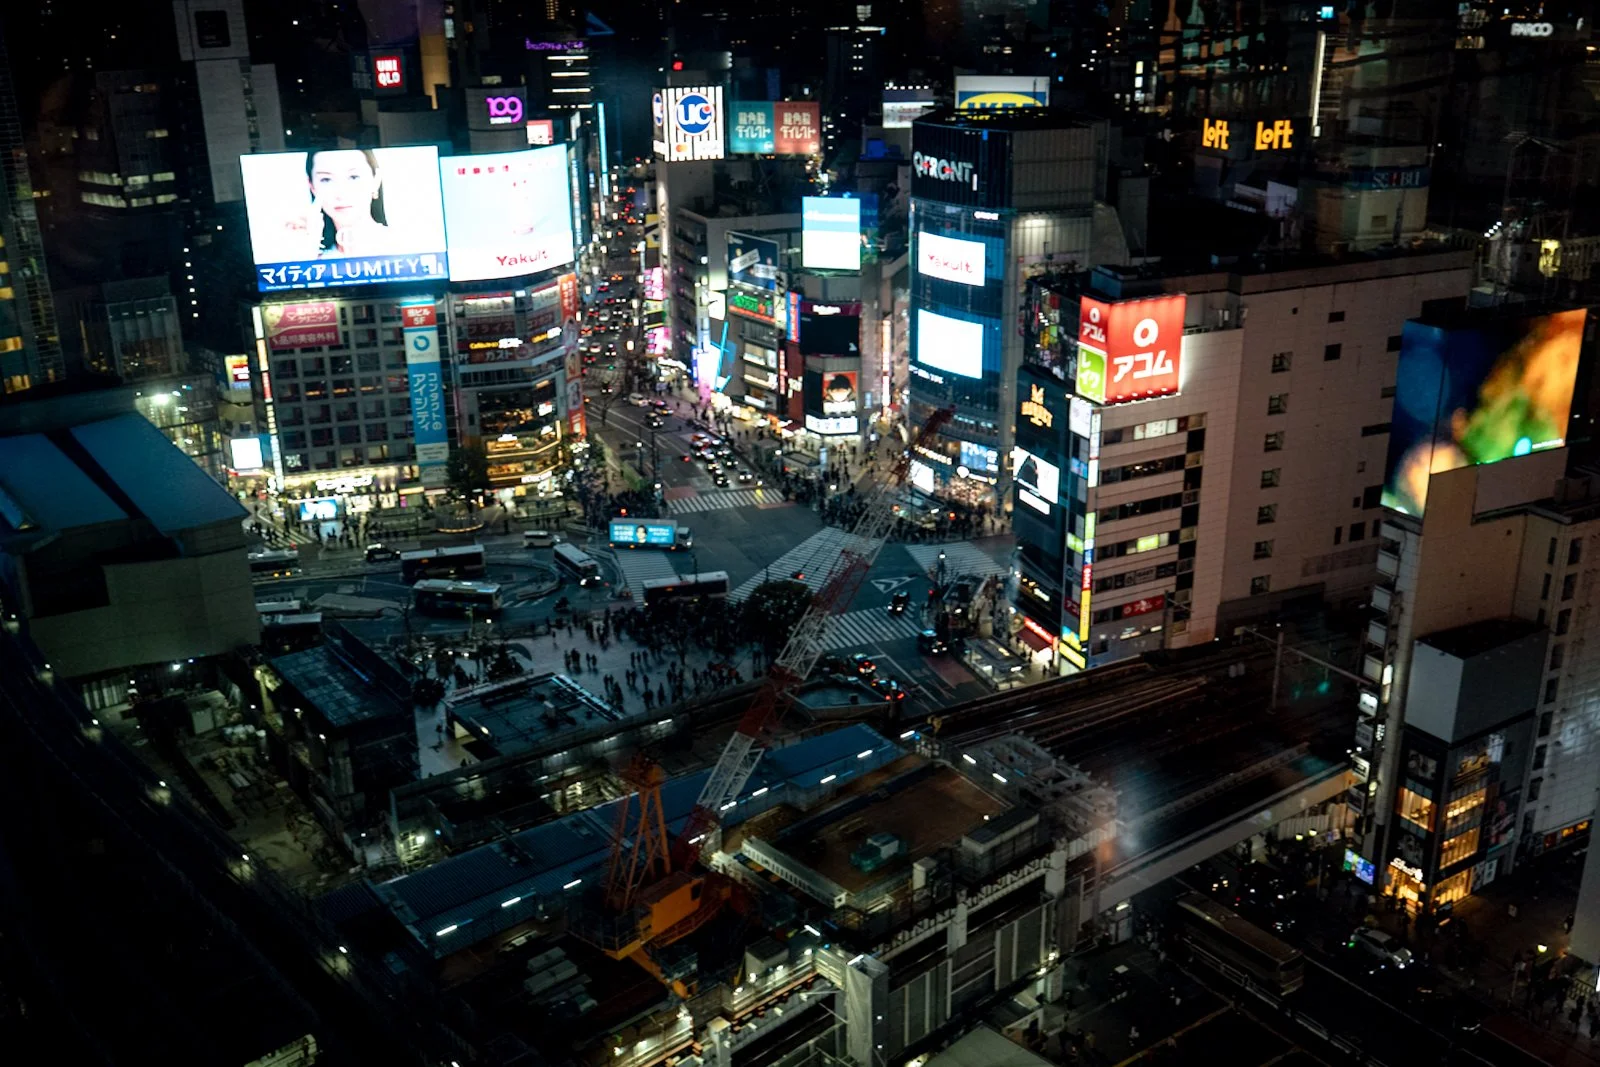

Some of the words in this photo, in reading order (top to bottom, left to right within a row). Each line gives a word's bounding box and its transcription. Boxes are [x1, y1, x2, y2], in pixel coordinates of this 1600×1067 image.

[1510, 22, 1554, 37] PARCO
[376, 59, 397, 72] UNI
[377, 71, 400, 86] QLO
[486, 96, 523, 123] 109
[912, 150, 974, 183] QFRONT
[496, 250, 549, 267] Yakult
[260, 264, 326, 284] マイティア
[331, 257, 420, 279] LUMIFY
[1082, 323, 1106, 343] アコム
[1113, 349, 1174, 383] アコム
[412, 373, 431, 431] アイシティ
